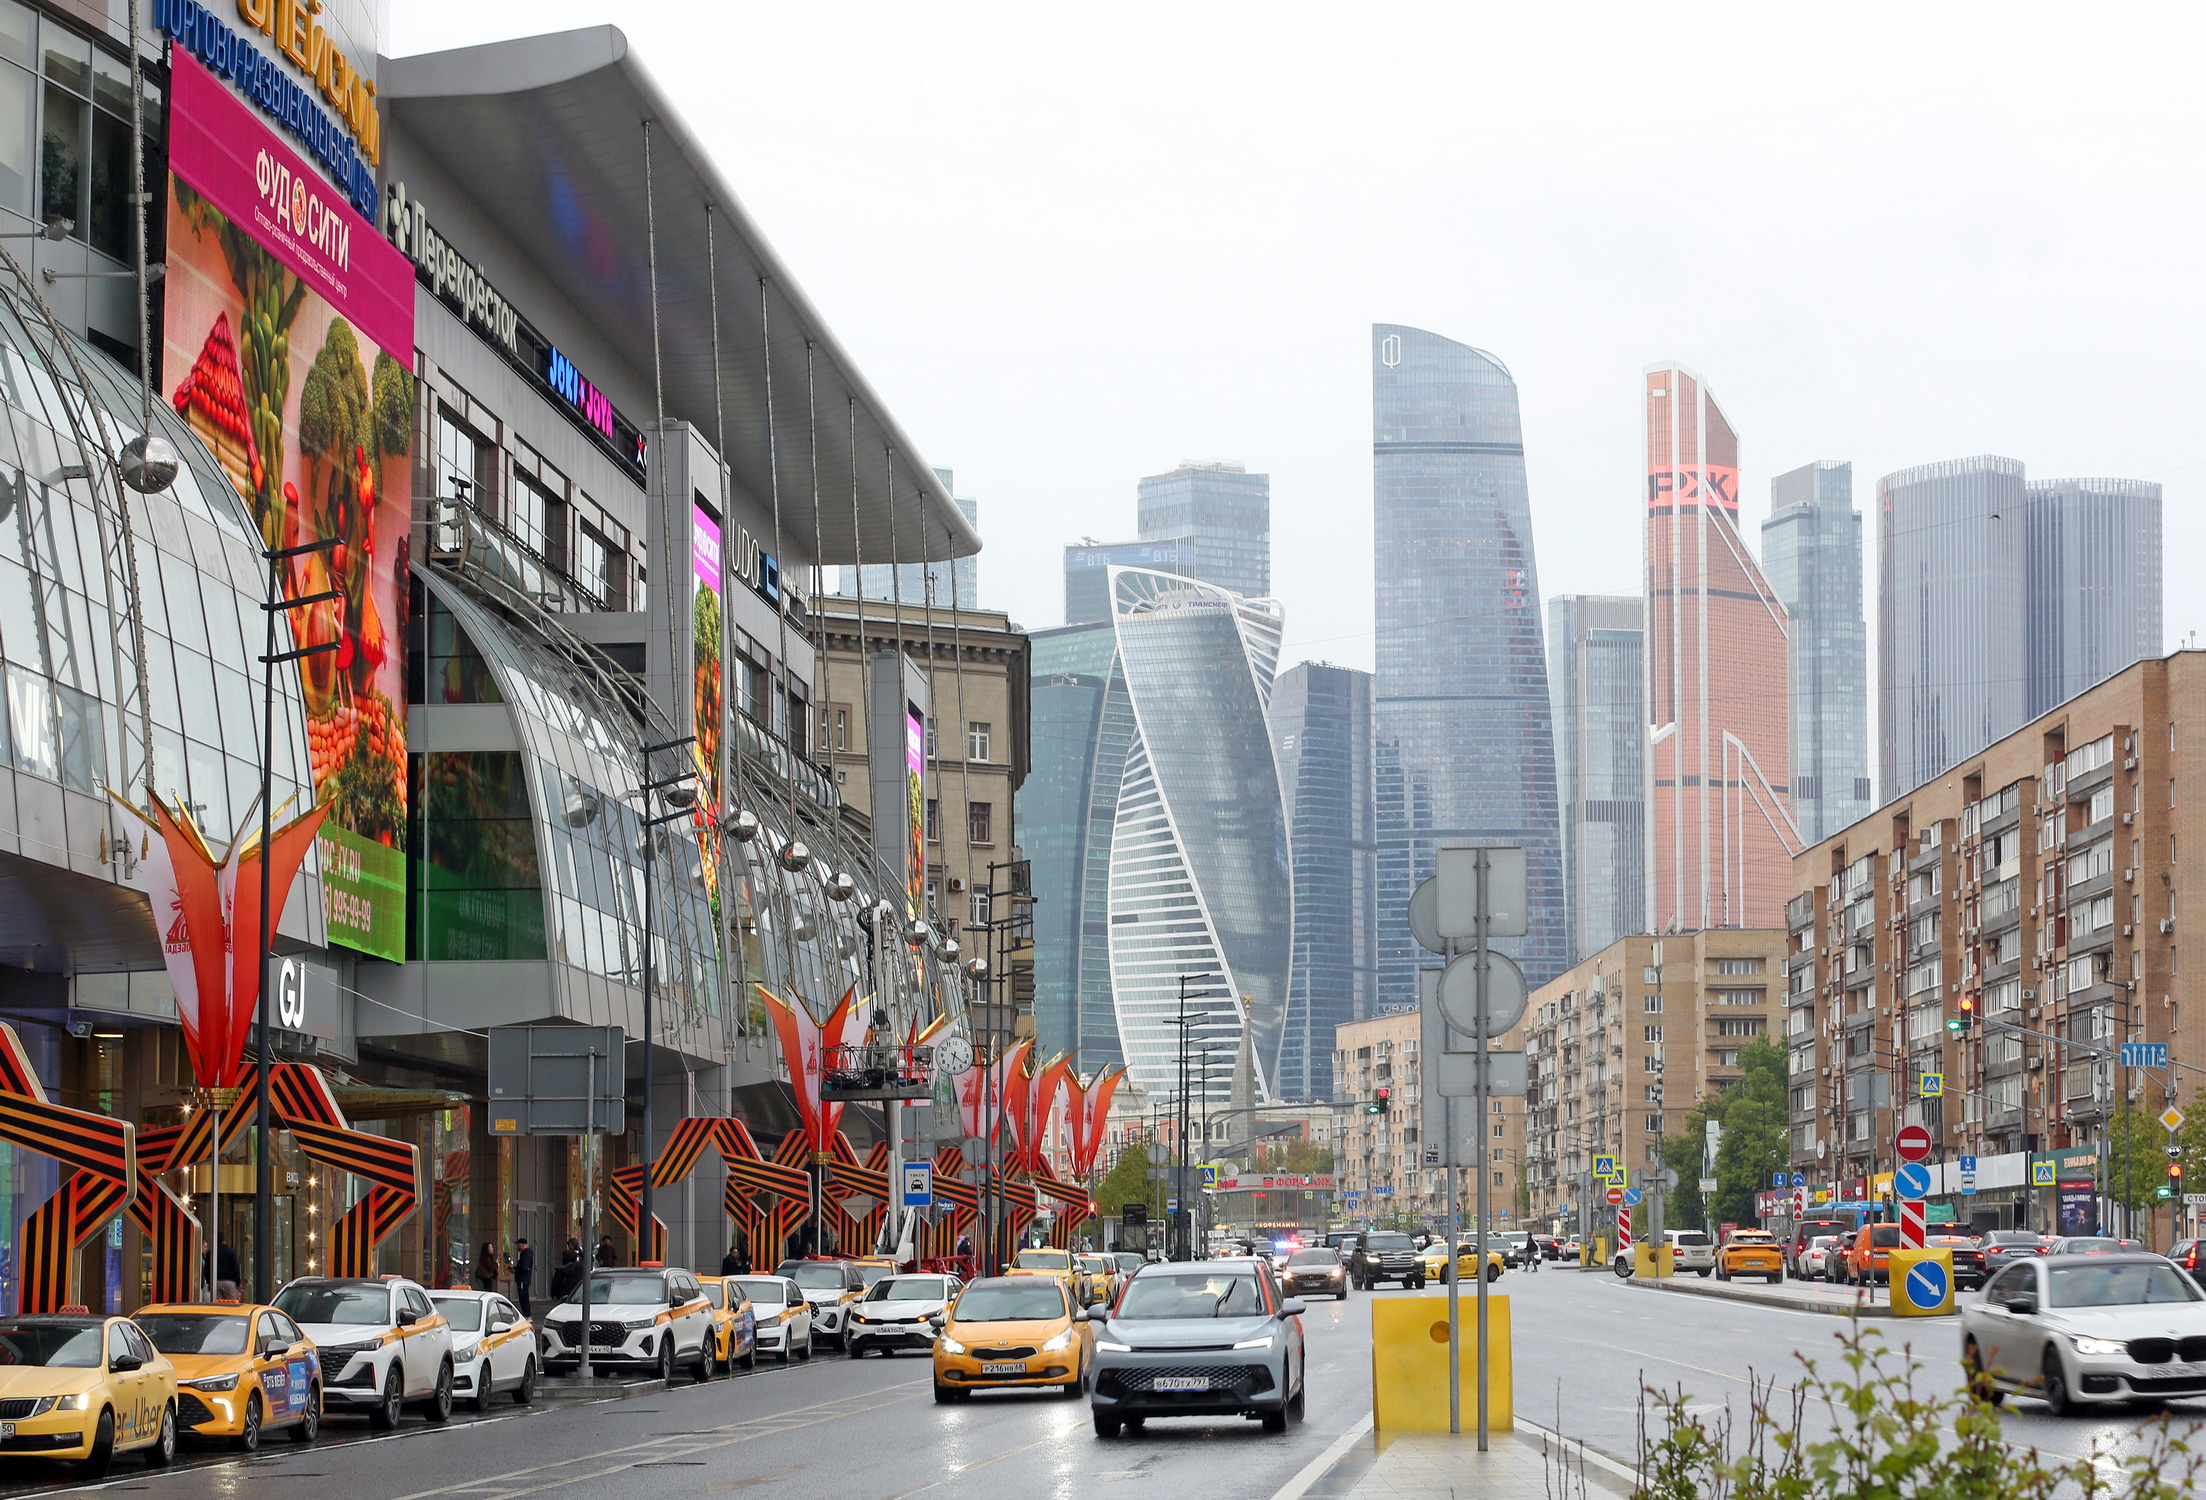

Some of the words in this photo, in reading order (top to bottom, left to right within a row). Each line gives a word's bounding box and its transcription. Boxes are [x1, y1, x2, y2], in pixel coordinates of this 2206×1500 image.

[413, 199, 519, 353] Перекрёсток
[549, 346, 579, 406] JOKI
[586, 381, 613, 439] JOYA
[1087, 553, 1110, 566] ВТБ
[1187, 601, 1229, 609] ТРАНСНЕФ
[333, 888, 371, 932] 995-99-99
[279, 958, 306, 1029] GJ
[2187, 1194, 2206, 1203] СТО
